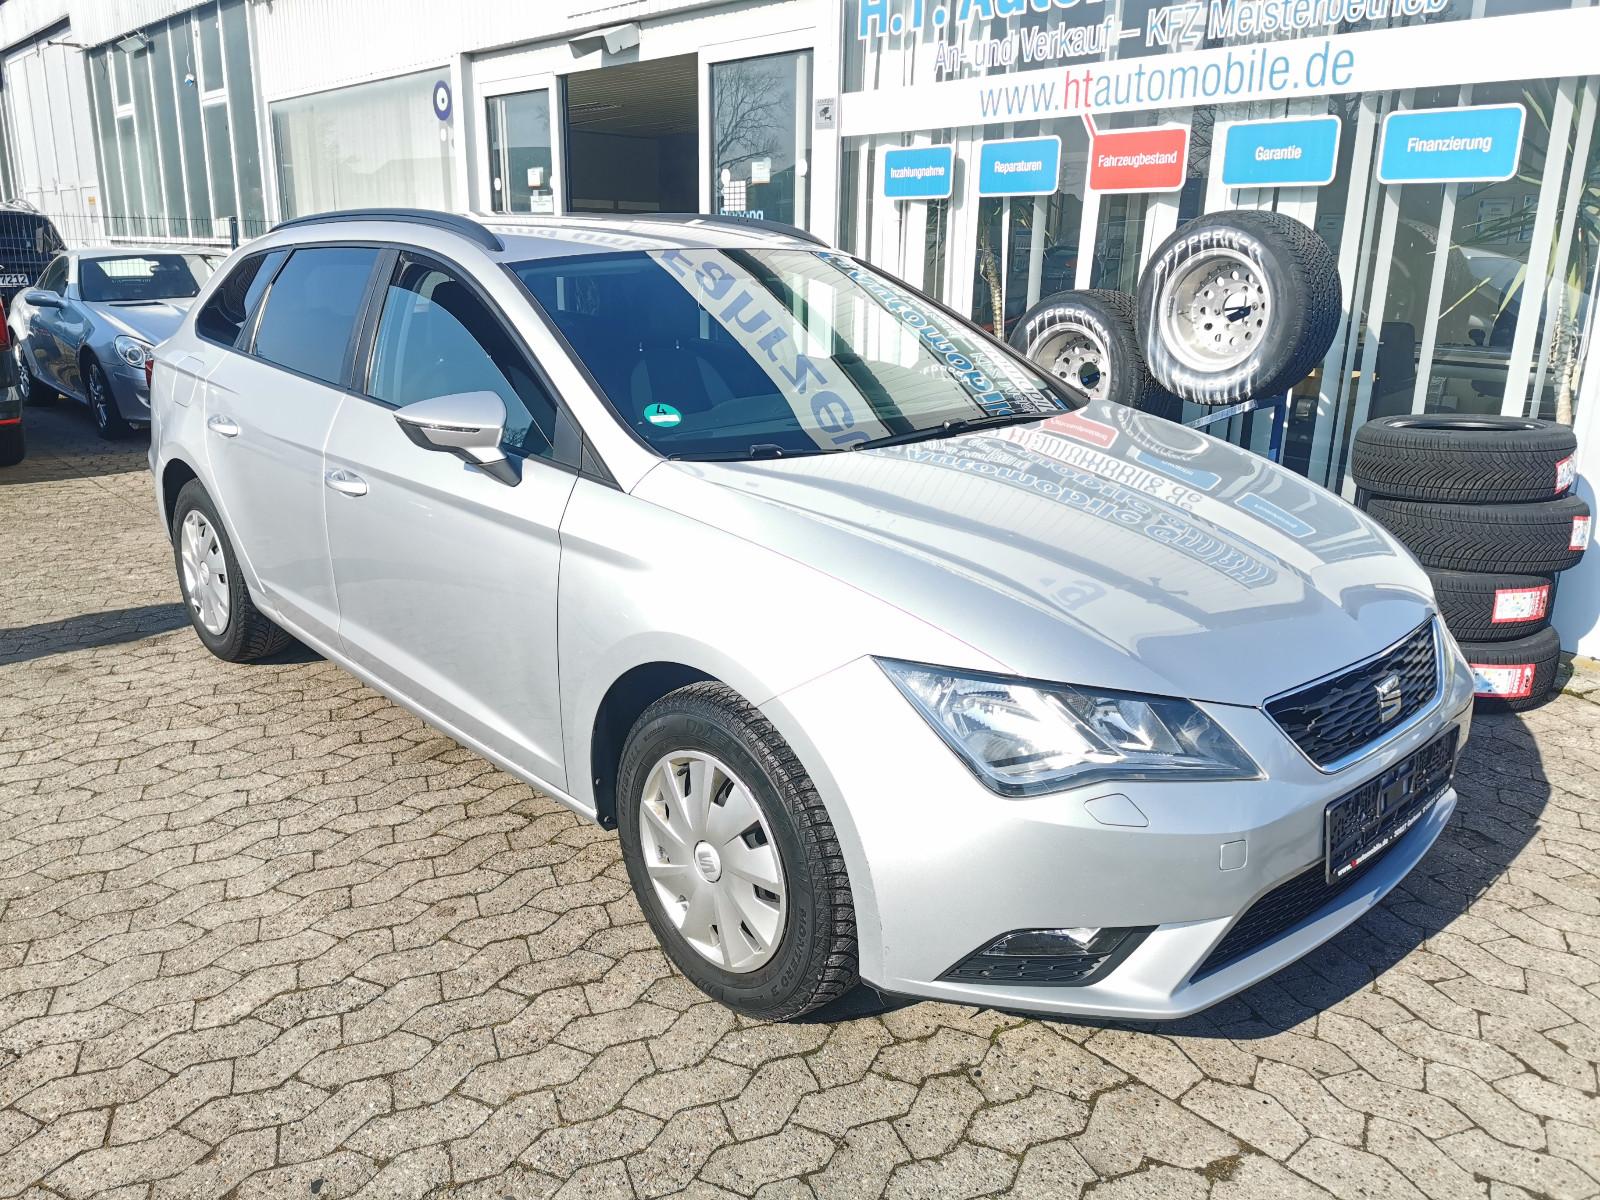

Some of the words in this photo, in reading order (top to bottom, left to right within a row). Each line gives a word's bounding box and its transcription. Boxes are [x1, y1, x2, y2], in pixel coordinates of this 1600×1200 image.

[974, 30, 1020, 68] und
[1021, 15, 1116, 63] Verkauf
[1146, 3, 1202, 47] KFZ
[979, 42, 1355, 118] www.htautomobile.de
[1407, 134, 1493, 154] Finanzierung
[1098, 150, 1178, 168] Fahrzeugbestand
[1255, 145, 1303, 162] Garantie
[890, 166, 946, 180] Inzahlungnahme
[994, 159, 1043, 175] Reparaturen
